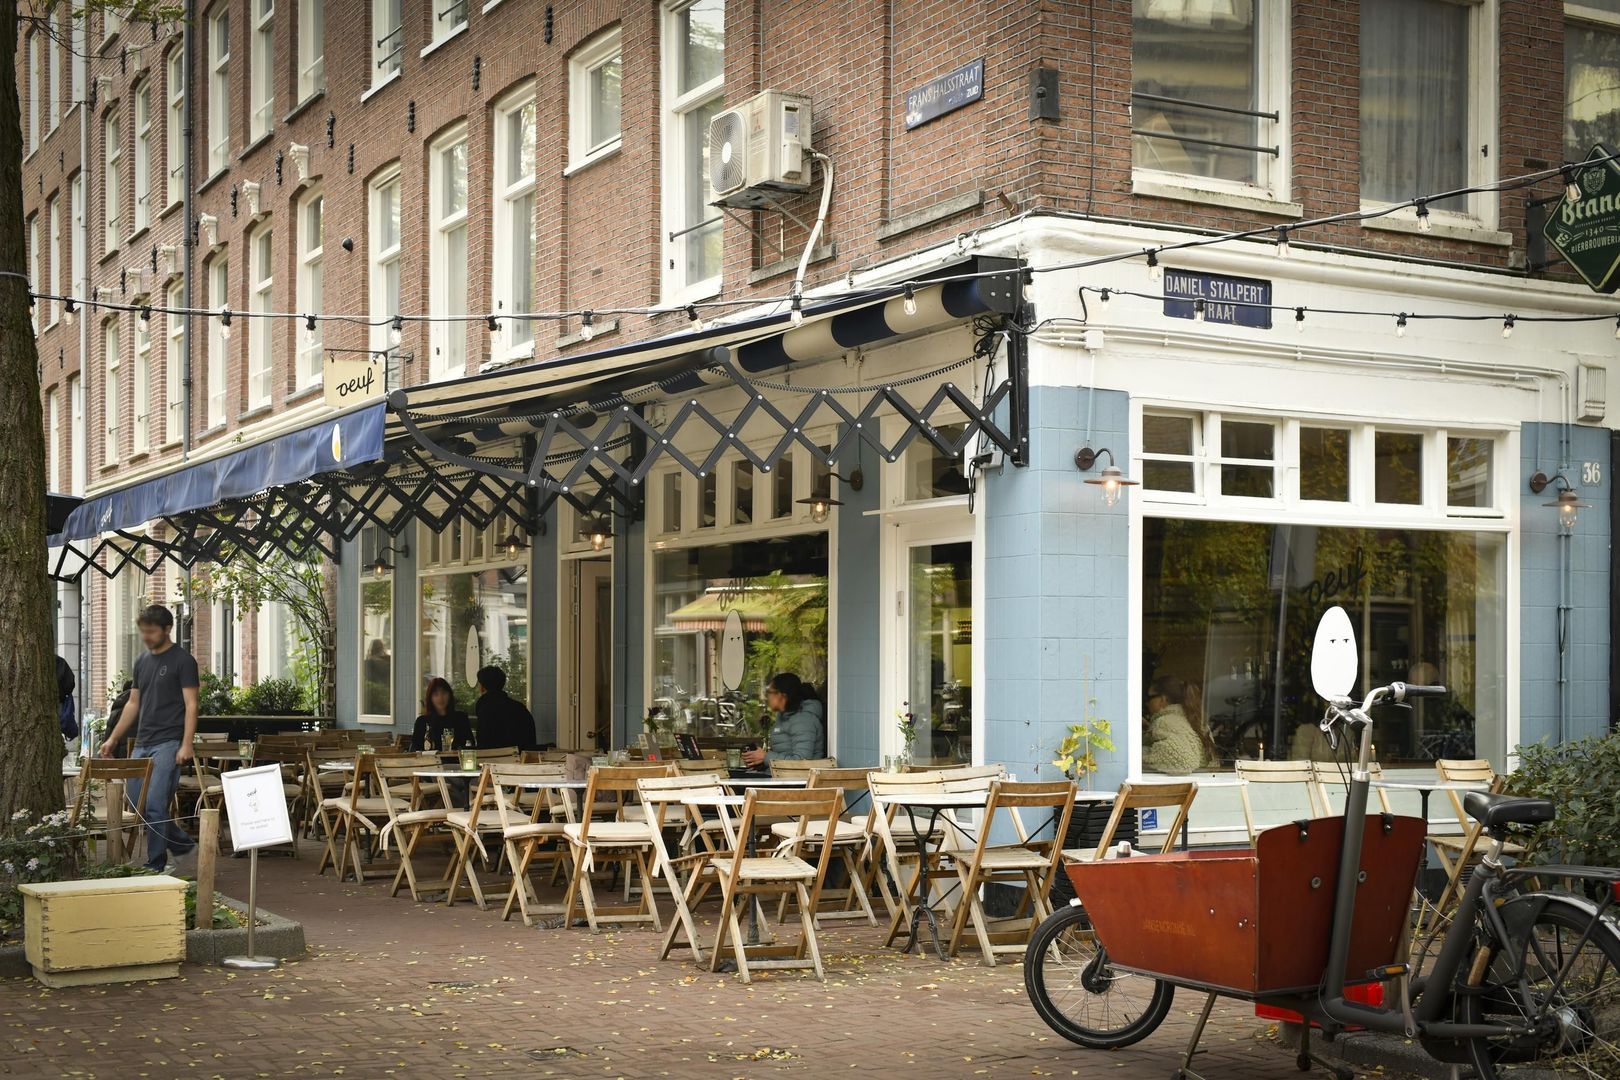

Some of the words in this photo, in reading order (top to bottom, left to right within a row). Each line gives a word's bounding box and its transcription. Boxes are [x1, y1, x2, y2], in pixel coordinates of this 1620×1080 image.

[908, 87, 932, 111] FRANS
[933, 66, 980, 100] HALSSTRAAT
[1585, 225, 1604, 238] 1340
[1166, 275, 1205, 296] DANIEL
[1210, 280, 1264, 303] STALPERT
[336, 367, 375, 397] oeuf
[1583, 462, 1601, 483] 36
[1301, 546, 1367, 607] oeuf
